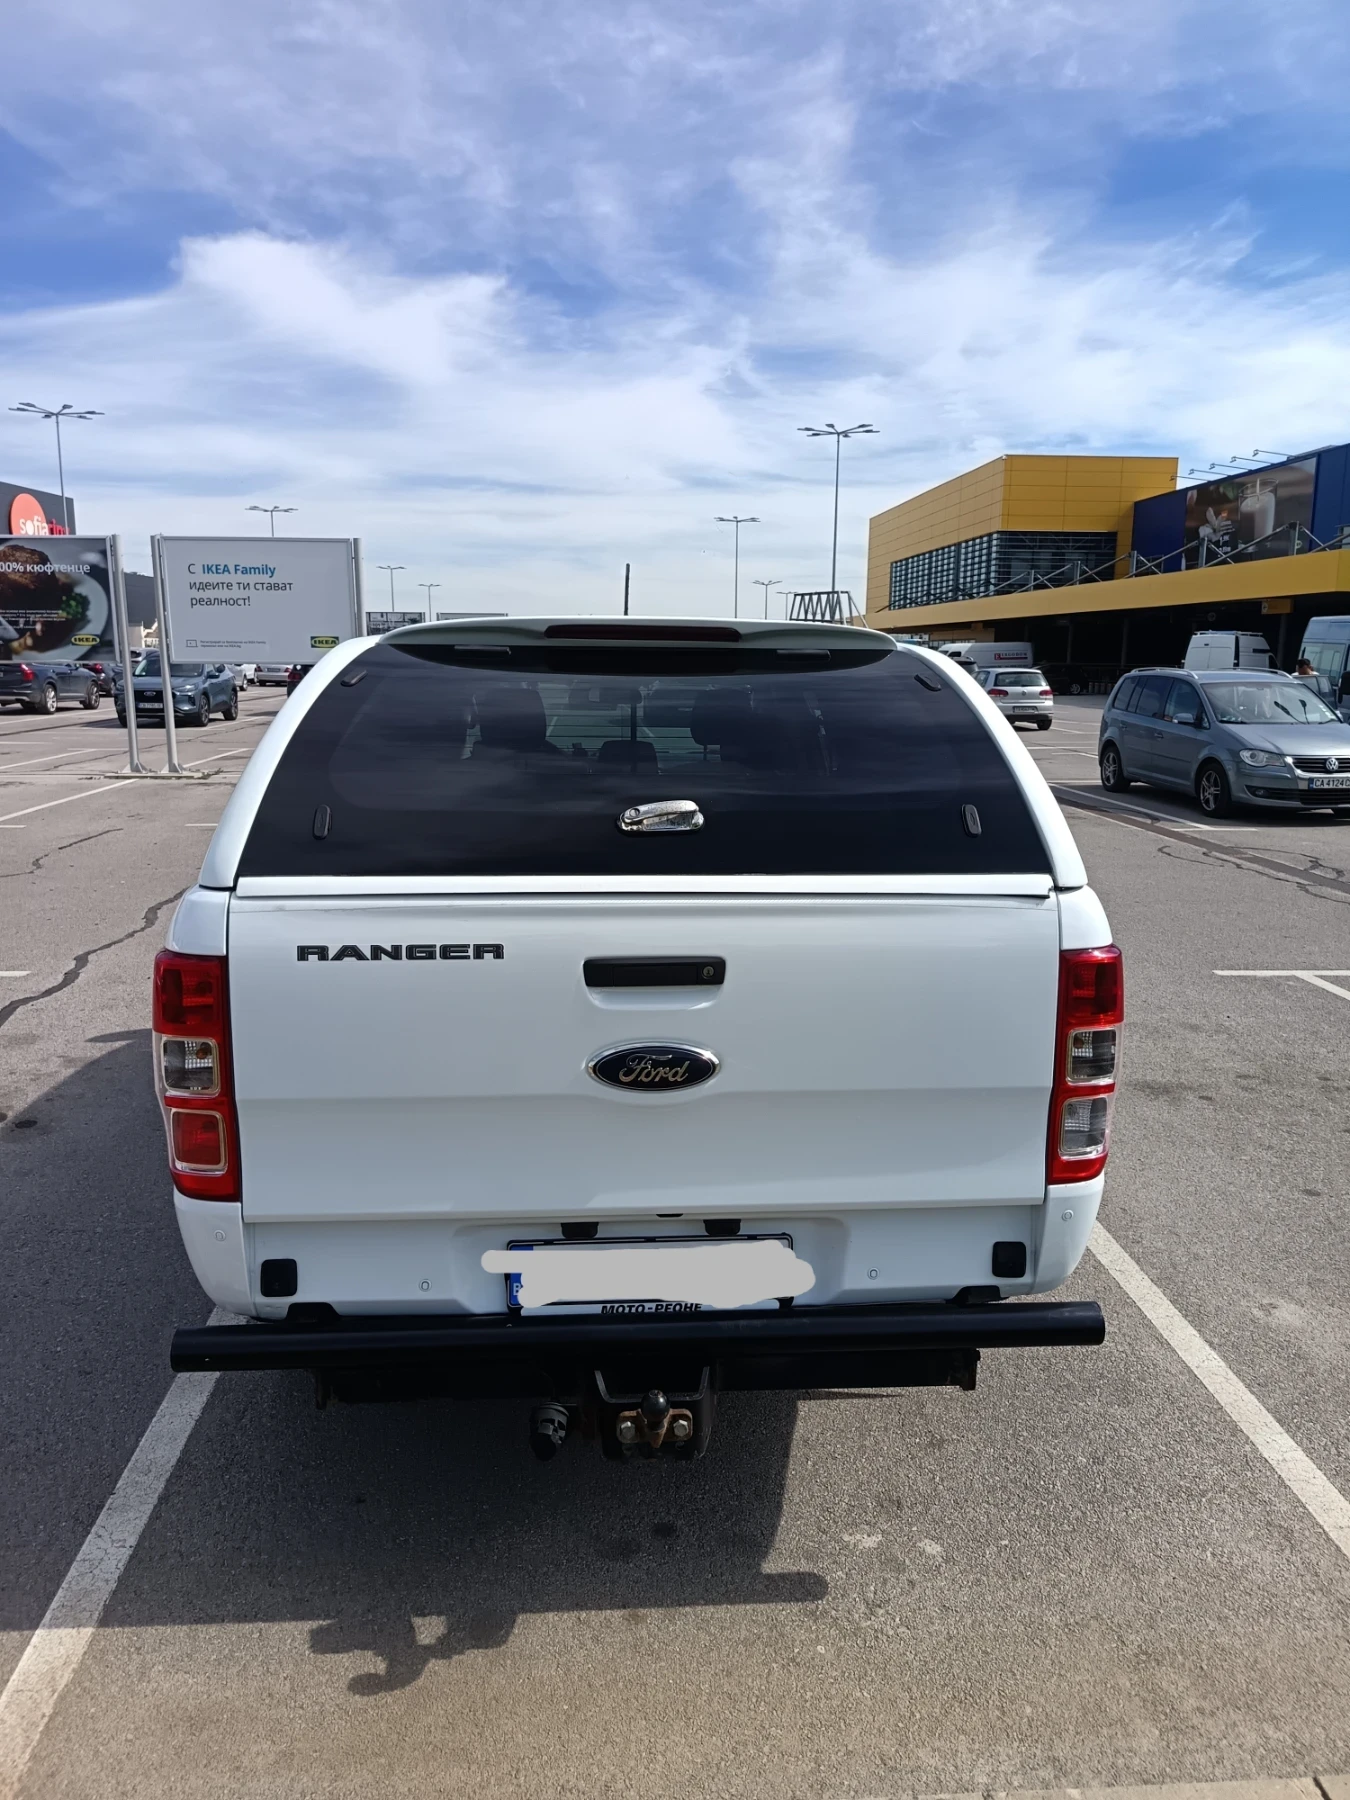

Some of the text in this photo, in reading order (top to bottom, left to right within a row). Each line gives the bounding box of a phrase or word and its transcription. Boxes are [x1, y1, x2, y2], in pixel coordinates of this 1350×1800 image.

[27, 562, 91, 575] кюфтенце
[202, 564, 231, 575] IKEA
[234, 564, 276, 578] Family
[189, 581, 293, 592] идеите ти стават
[190, 596, 251, 609] реалност!
[297, 944, 504, 961] RANGER
[619, 1053, 691, 1083] Ford
